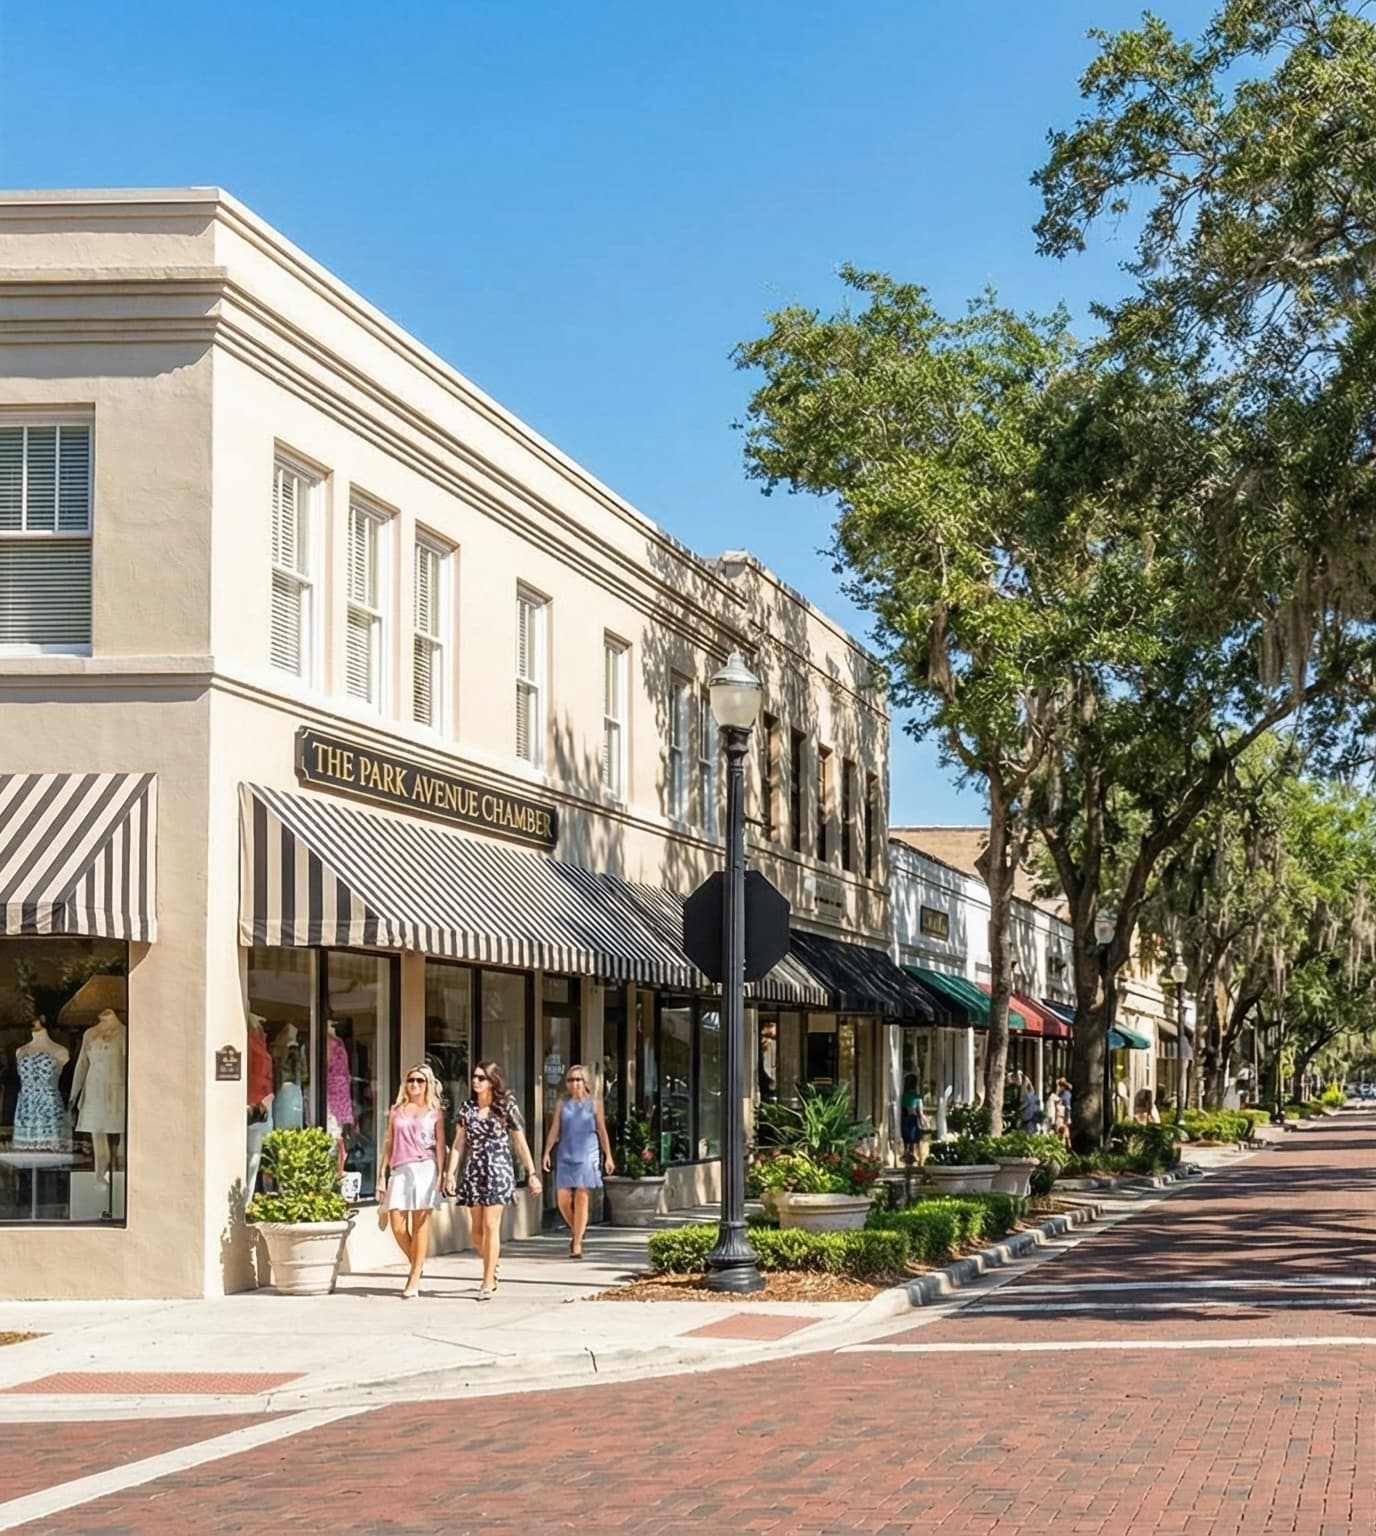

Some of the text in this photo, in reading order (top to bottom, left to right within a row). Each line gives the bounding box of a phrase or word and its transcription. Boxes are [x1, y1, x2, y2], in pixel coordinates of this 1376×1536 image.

[312, 741, 552, 838] THE PARK AVENUE CHAMBER
